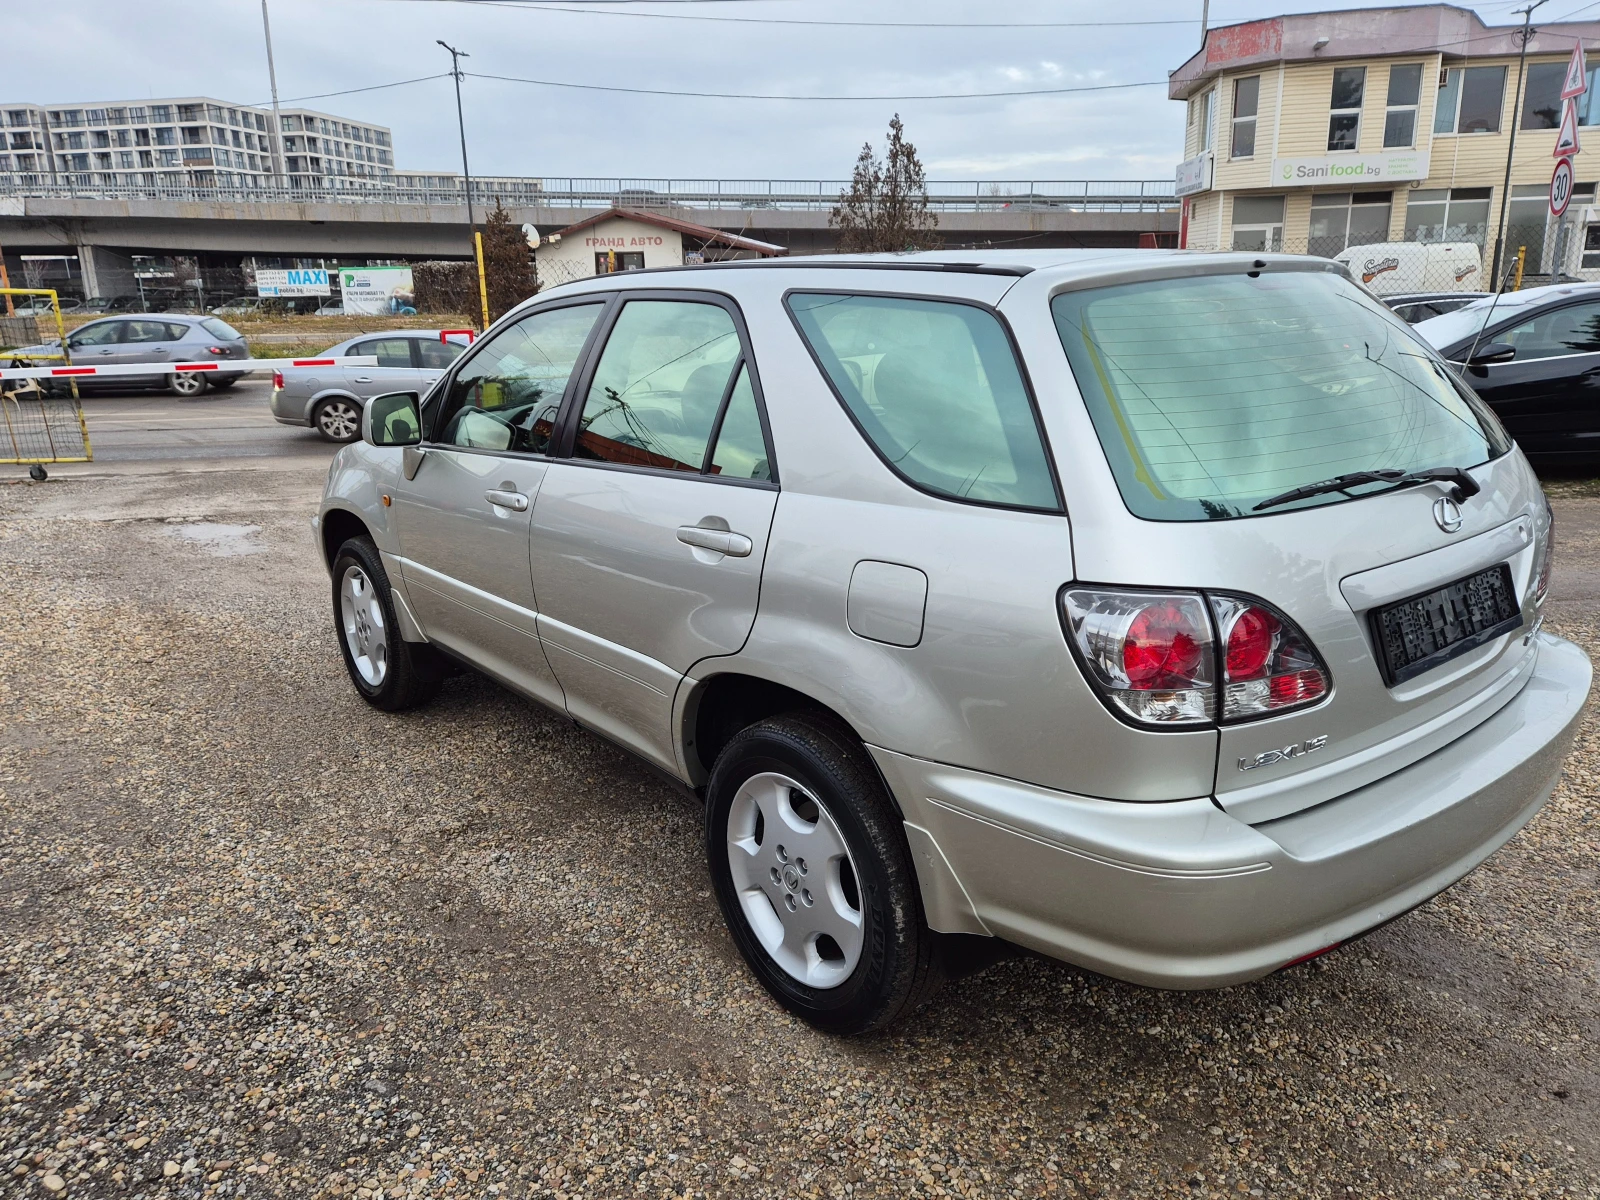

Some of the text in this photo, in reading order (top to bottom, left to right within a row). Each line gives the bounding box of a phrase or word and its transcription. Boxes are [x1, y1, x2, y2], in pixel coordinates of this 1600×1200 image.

[1554, 173, 1568, 201] 30
[585, 236, 663, 247] ГРАНД АВТО
[288, 270, 328, 285] MAXI
[1237, 734, 1328, 771] LEXUS
